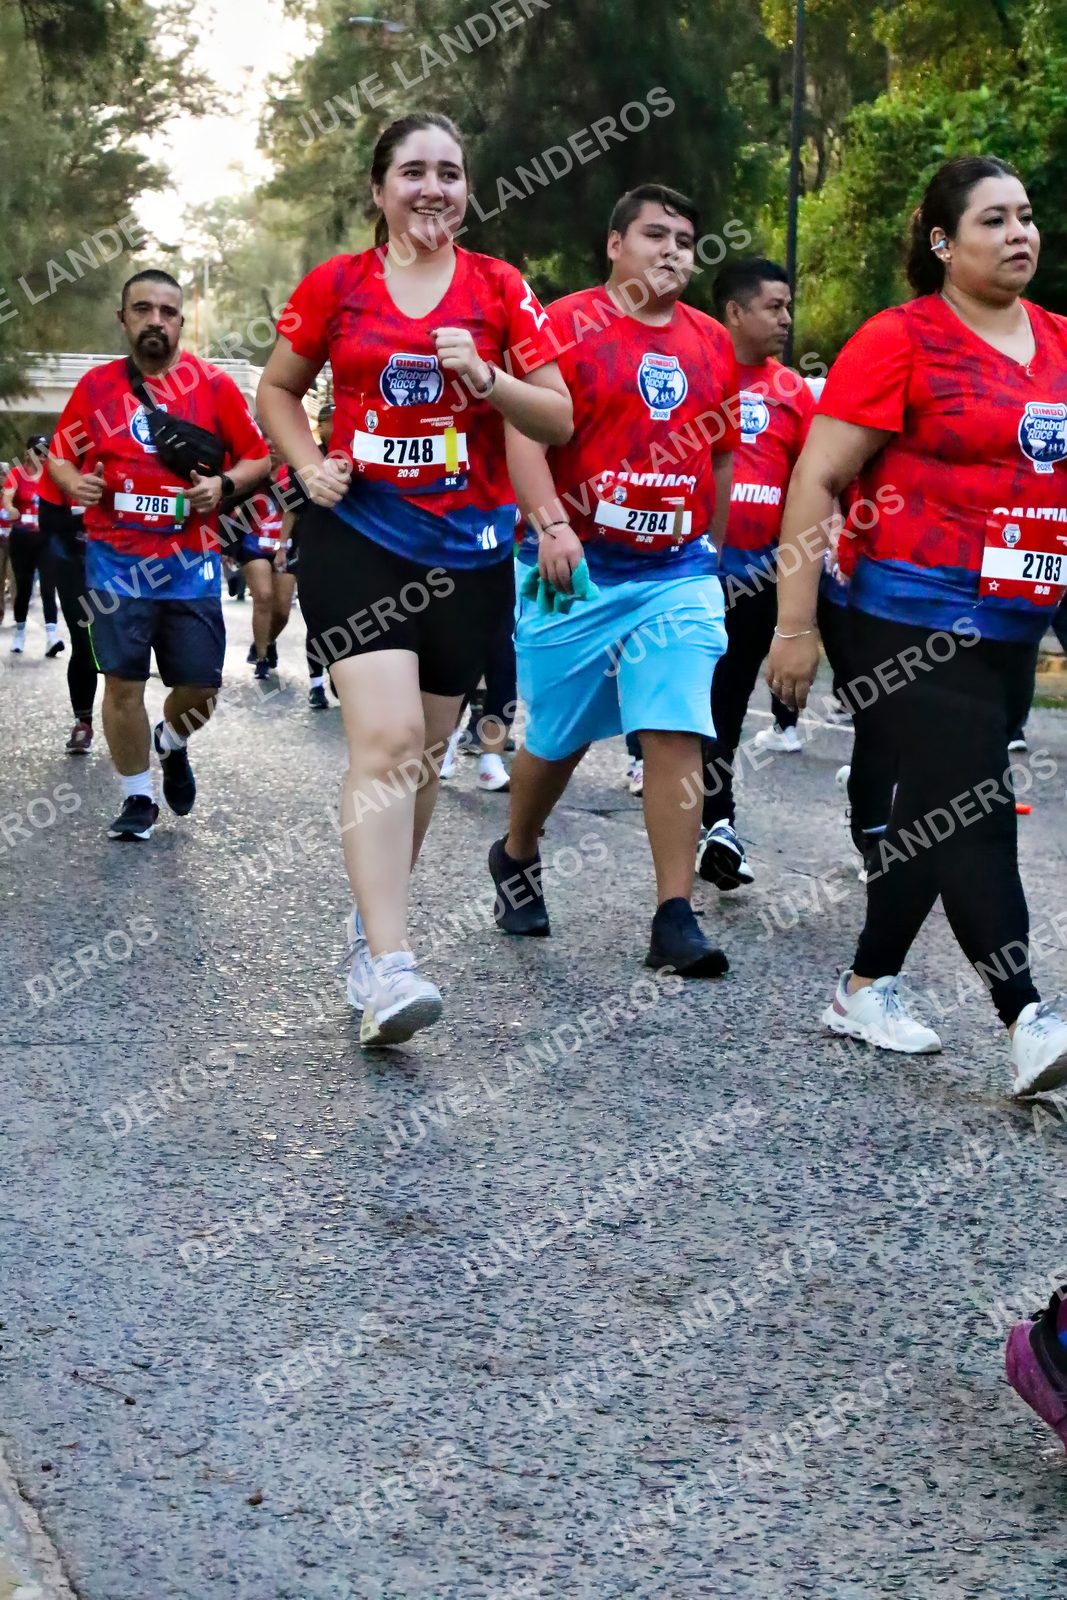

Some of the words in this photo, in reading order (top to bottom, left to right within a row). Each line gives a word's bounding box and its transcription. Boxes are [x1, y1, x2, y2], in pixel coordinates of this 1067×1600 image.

[396, 369, 430, 380] Global
[650, 368, 676, 381] Global
[389, 378, 416, 389] Race
[645, 376, 665, 388] Race
[1034, 418, 1066, 432] Global
[1027, 427, 1054, 441] Race
[383, 438, 434, 464] 2748
[445, 477, 457, 486] 5K
[730, 482, 782, 506] NTIAGO
[135, 496, 169, 514] 2786
[625, 510, 669, 533] 2784
[1022, 552, 1063, 582] 2783
